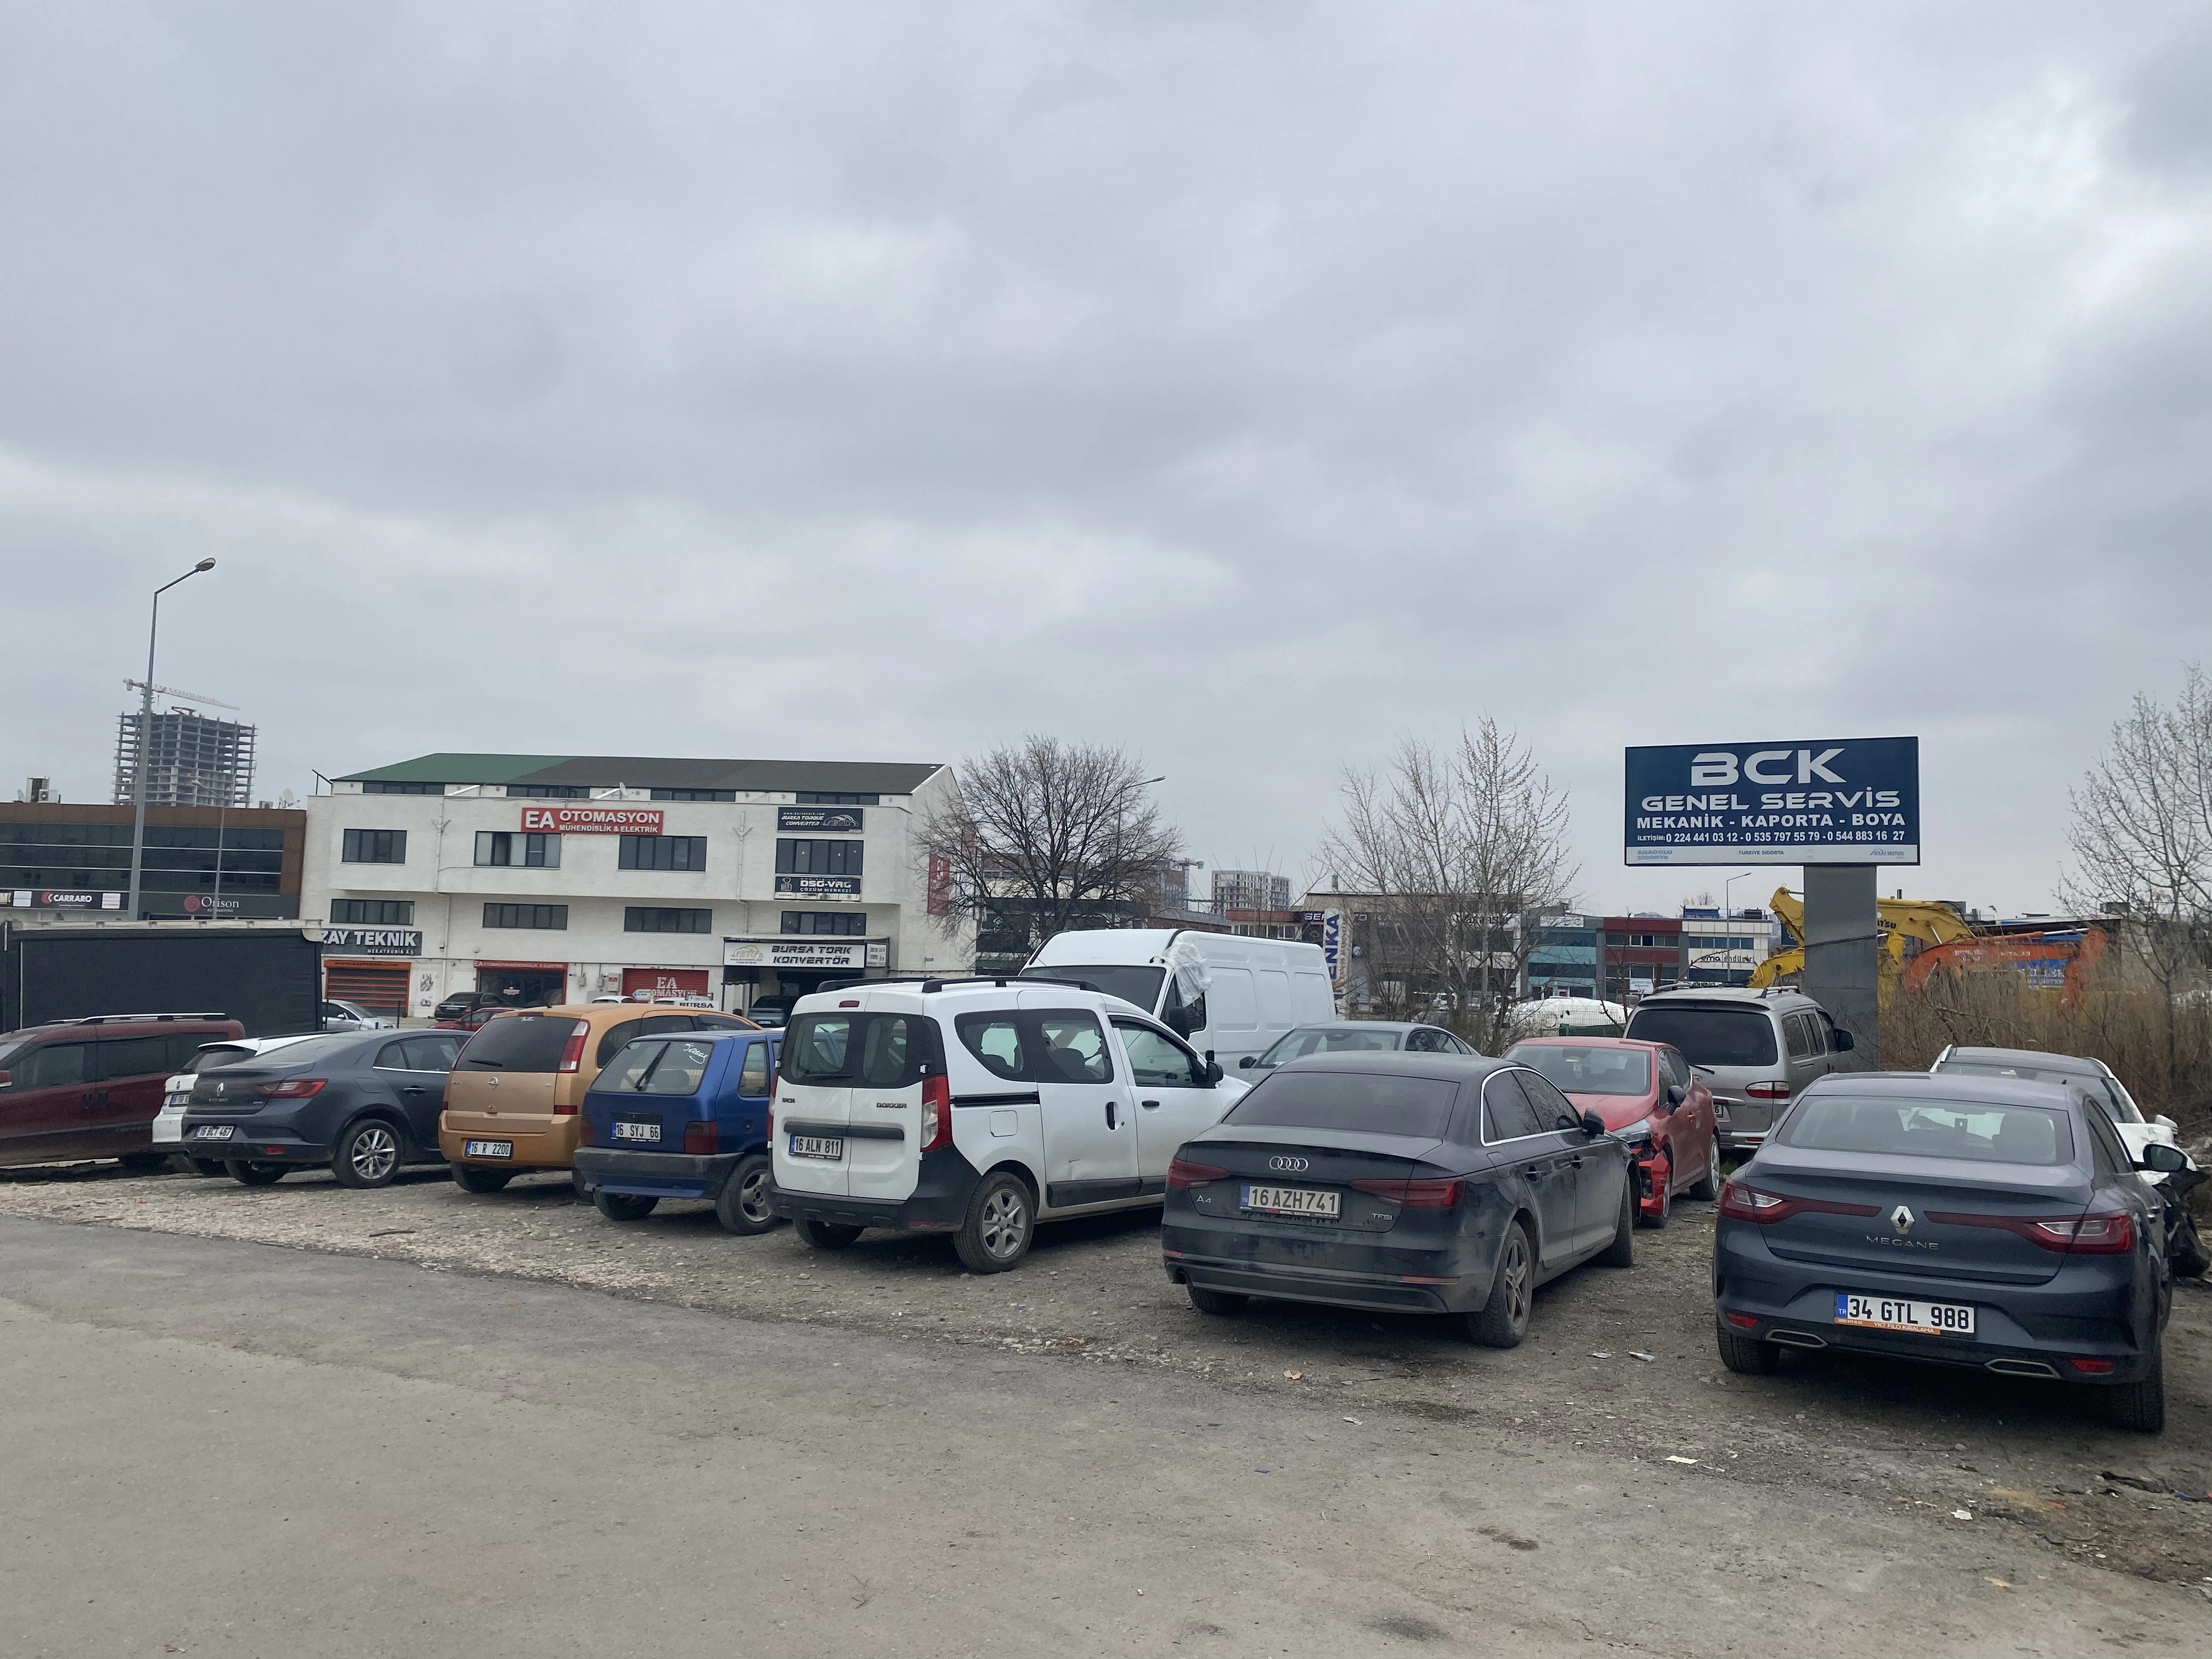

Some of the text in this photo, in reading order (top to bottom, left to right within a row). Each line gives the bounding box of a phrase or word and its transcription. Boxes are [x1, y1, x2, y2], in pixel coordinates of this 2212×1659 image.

[1691, 748, 1847, 786] BCK
[1641, 786, 1900, 811] GENEL SERVİS
[525, 810, 659, 829] EA OTOMASYON
[1637, 813, 1724, 829] MEKANİK
[1742, 814, 1833, 827] KAPORTA
[1852, 813, 1906, 826] BOYA
[559, 823, 612, 832] MÜHENDİSLİK
[1666, 833, 1672, 843] 0
[1674, 833, 1691, 843] 224
[1693, 833, 1709, 842] 441
[1712, 833, 1724, 842] 03
[1726, 832, 1738, 842] 12
[1745, 832, 1751, 842] 0
[1754, 832, 1771, 842] 535
[1774, 832, 1791, 842] 797
[1794, 832, 1805, 841] 55
[1808, 831, 1820, 841] 79
[1827, 831, 1833, 840] 0
[1836, 831, 1853, 840] 544
[1855, 831, 1873, 840] 883
[1876, 831, 1887, 840] 16
[1893, 831, 1905, 840] 27
[800, 879, 852, 888] DSG-VAG
[53, 894, 93, 903] CARRARO
[201, 896, 240, 908] Orison
[354, 928, 416, 946] TEKNİK
[771, 945, 853, 955] BURSA TORK
[773, 956, 850, 964] KONVERTÖR
[656, 977, 678, 989] EA
[199, 1126, 207, 1136] 16
[617, 1124, 659, 1138] 16 SYJ 66
[471, 1143, 510, 1155] 16 R 2200
[795, 1137, 839, 1155] 16 ALN 811
[1196, 1194, 1211, 1204] A4
[1252, 1188, 1269, 1206] 16
[1272, 1190, 1303, 1210] AZH
[1306, 1193, 1336, 1212] 741
[1372, 1212, 1392, 1221] TFSI
[1866, 1235, 1939, 1250] MEGANE
[1849, 1298, 1872, 1319] 34
[1881, 1301, 1918, 1324] GTL
[1931, 1306, 1969, 1329] 988
